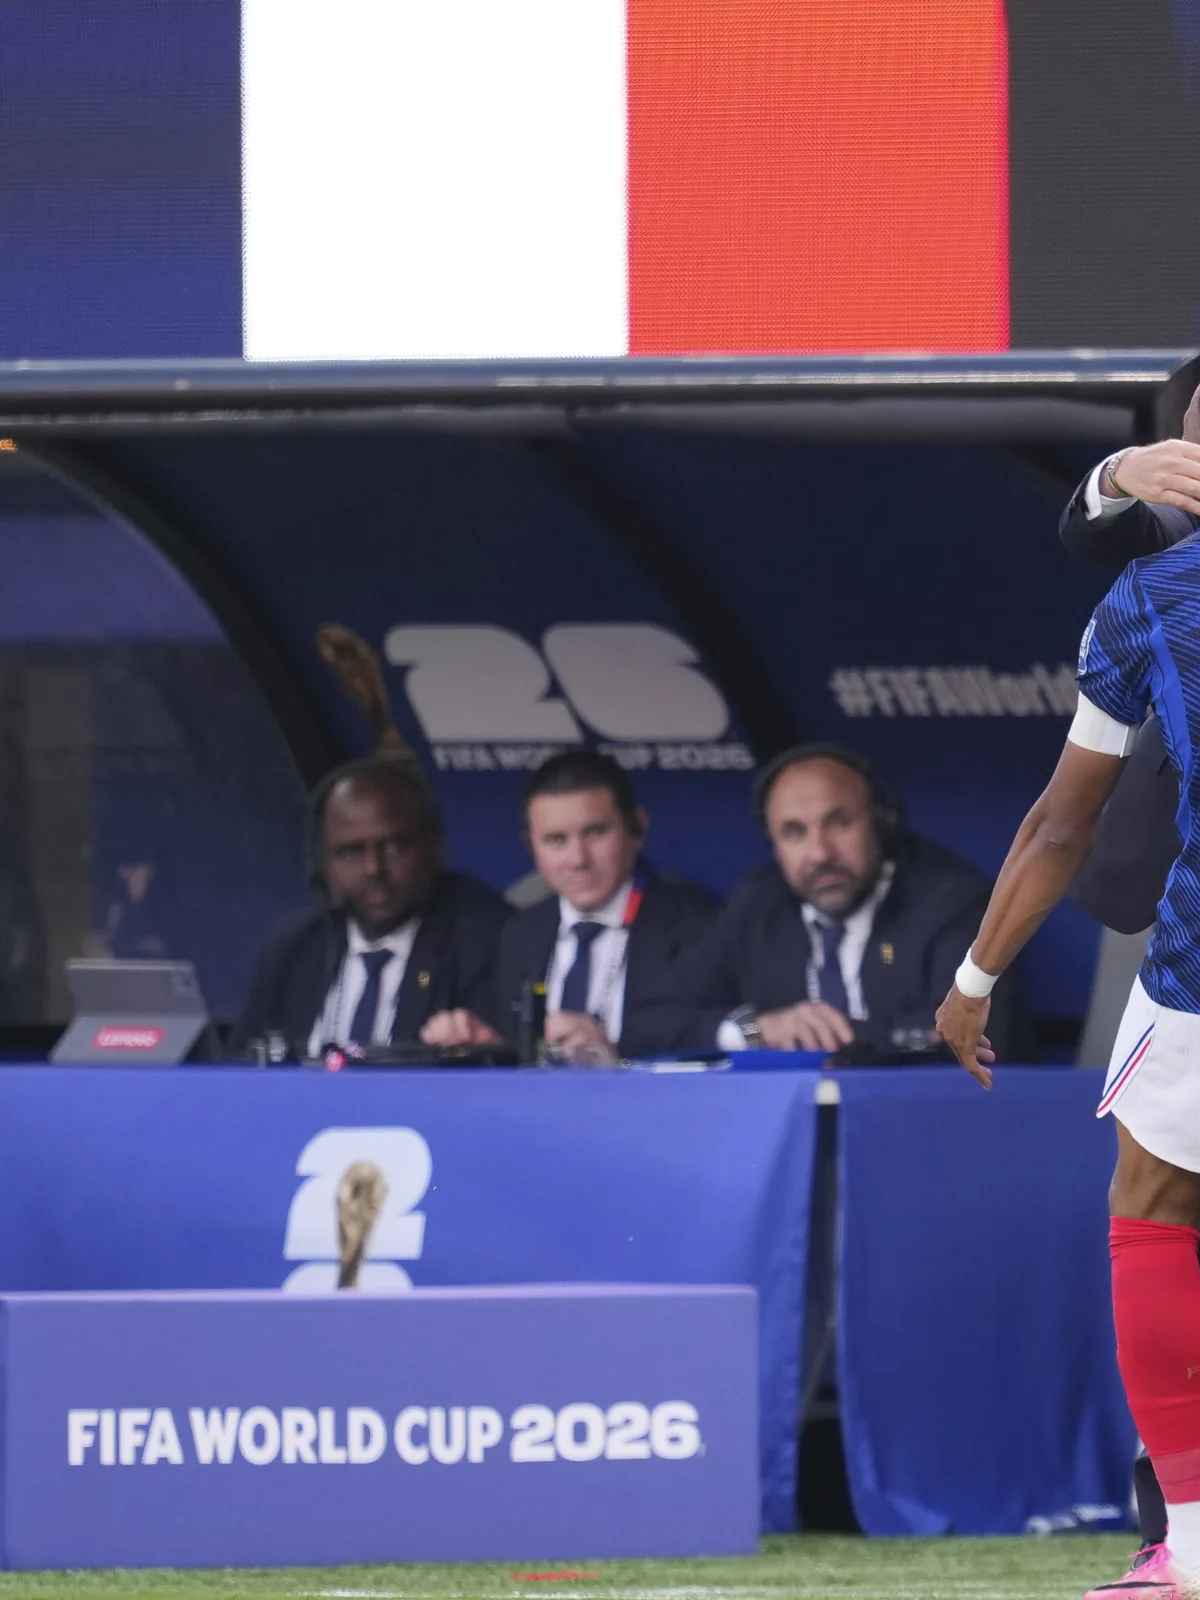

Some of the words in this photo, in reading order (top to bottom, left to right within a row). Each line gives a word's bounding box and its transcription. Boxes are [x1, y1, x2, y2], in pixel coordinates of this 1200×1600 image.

[434, 744, 497, 770] FIFA
[655, 744, 756, 770] 2026
[67, 1408, 185, 1466] FIFA
[188, 1405, 388, 1465] WORLD
[394, 1405, 504, 1465] CUP
[509, 1400, 702, 1462] 2026
